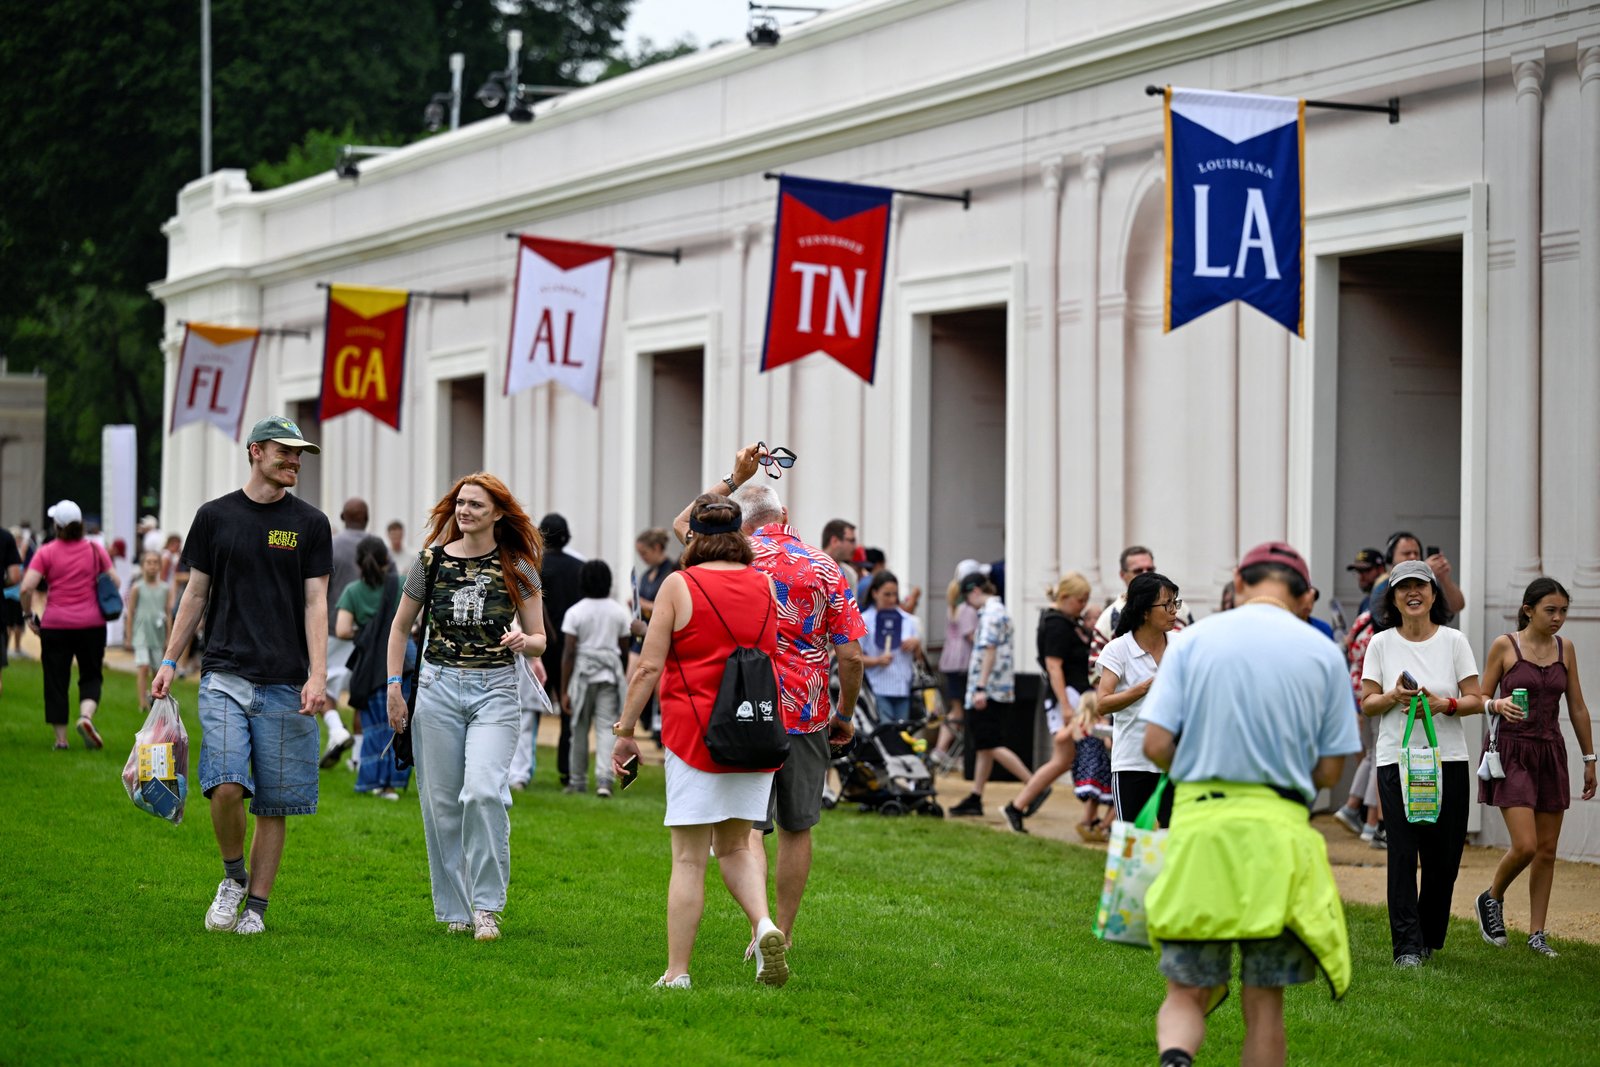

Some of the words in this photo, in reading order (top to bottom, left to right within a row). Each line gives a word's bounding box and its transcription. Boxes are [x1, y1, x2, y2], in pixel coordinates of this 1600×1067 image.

[1198, 158, 1274, 179] LOUISIANA
[1193, 184, 1282, 280] LA
[790, 261, 867, 338] TN
[528, 306, 583, 368] AL
[186, 365, 228, 415] FL
[333, 344, 388, 402] GA
[268, 536, 297, 547] WORLD
[269, 530, 298, 539] SPIRIT
